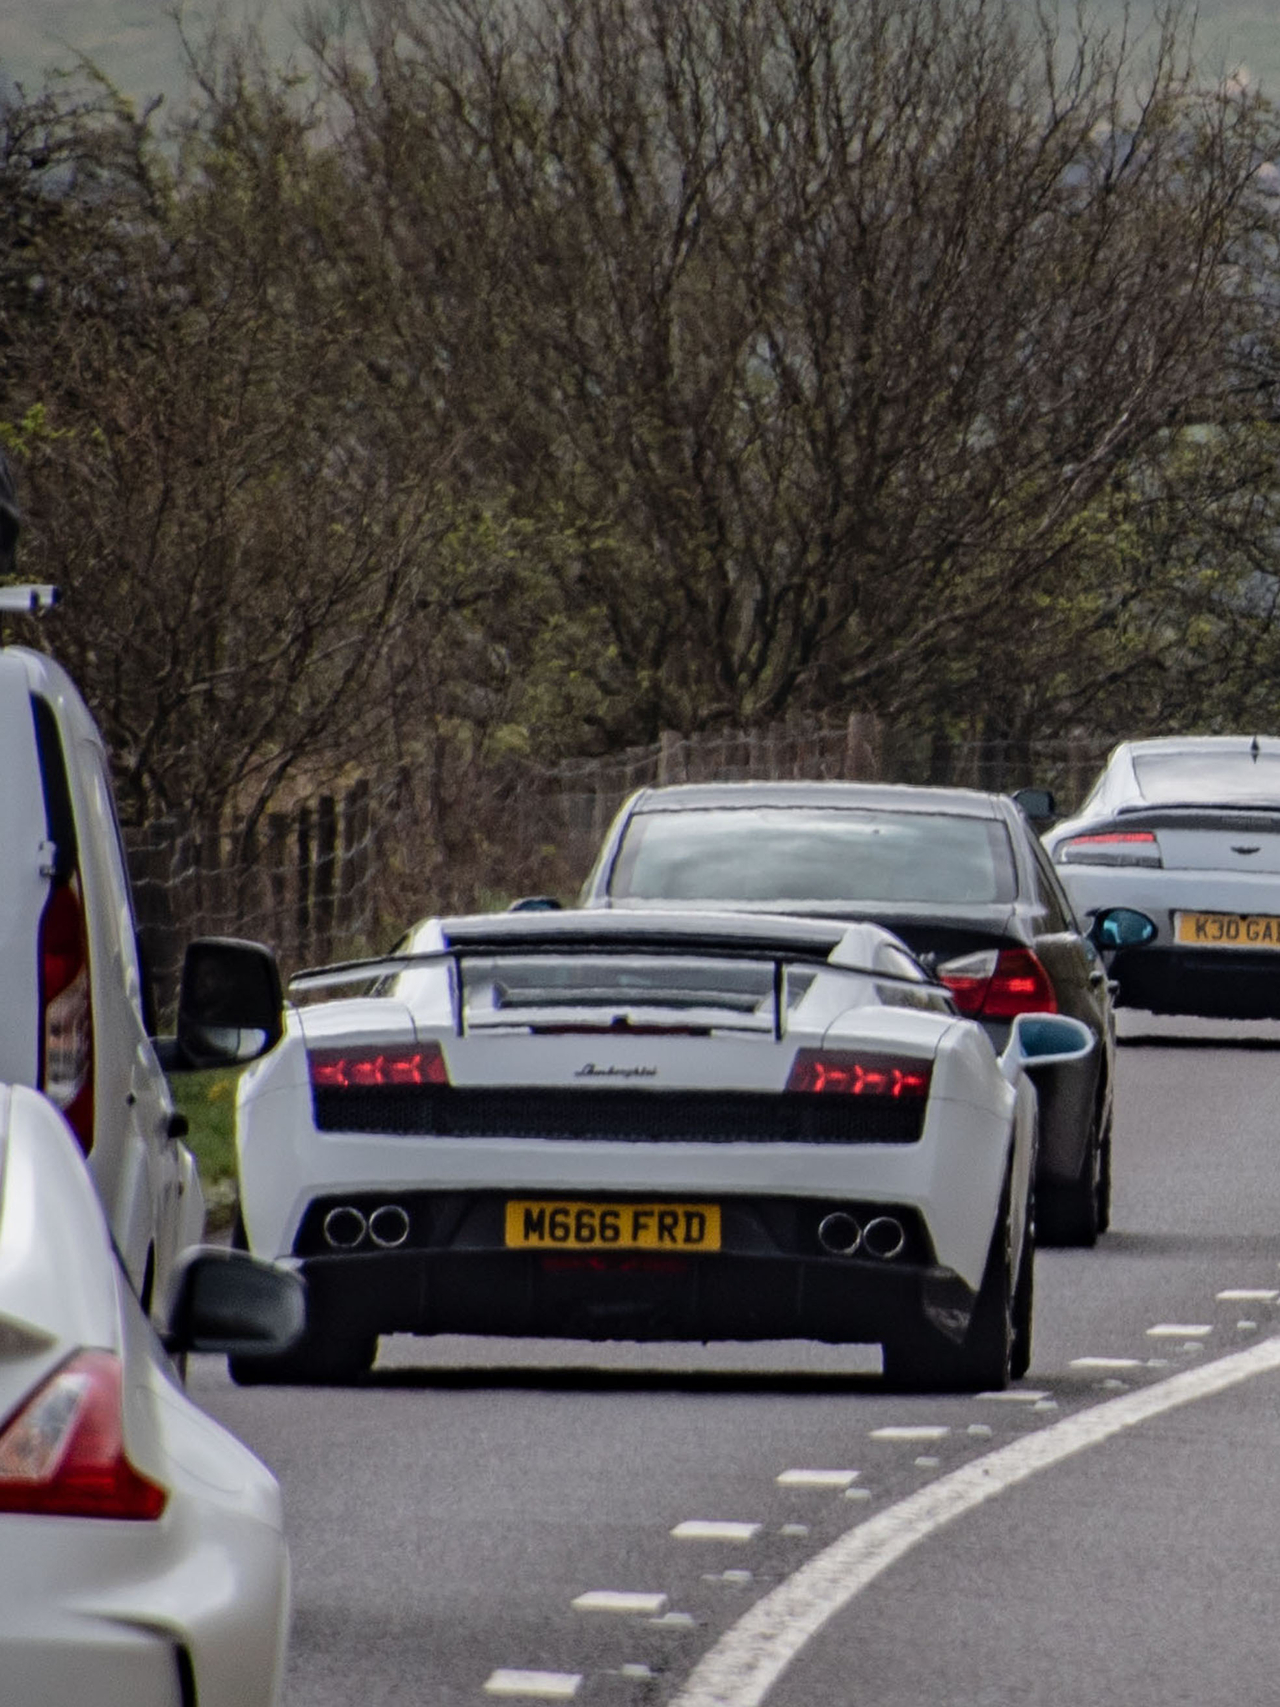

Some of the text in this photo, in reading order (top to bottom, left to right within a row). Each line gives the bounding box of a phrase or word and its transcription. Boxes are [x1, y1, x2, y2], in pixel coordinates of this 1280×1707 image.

[1195, 917, 1241, 942] K30
[523, 1207, 706, 1244] M666 FRD
